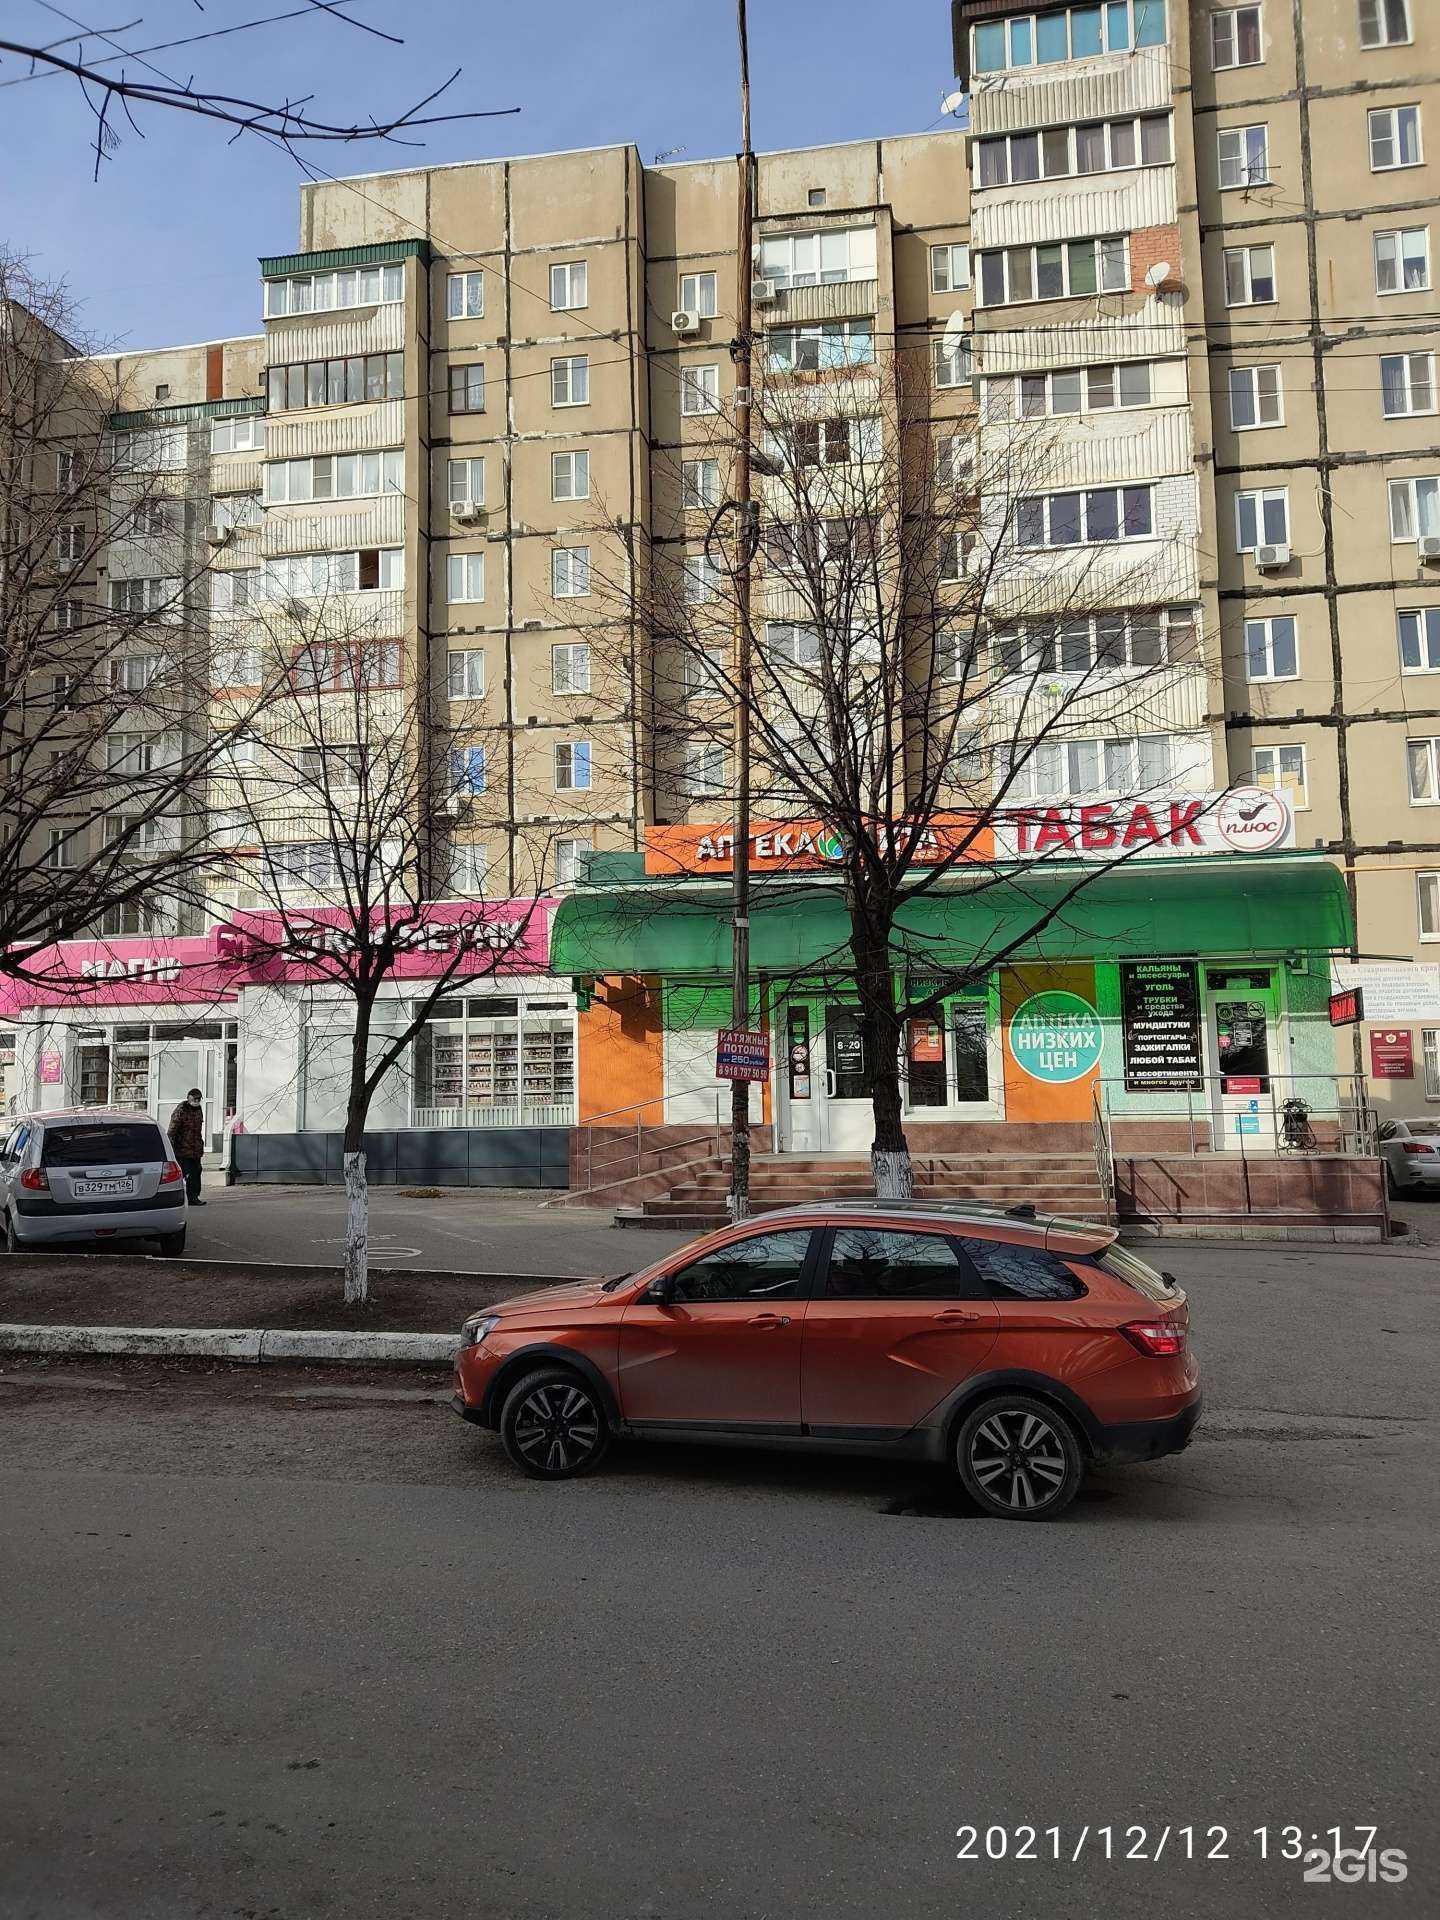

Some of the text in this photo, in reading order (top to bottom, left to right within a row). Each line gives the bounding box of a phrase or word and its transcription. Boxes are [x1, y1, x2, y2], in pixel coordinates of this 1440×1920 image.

[1009, 800, 1205, 853] ТАБАК
[696, 831, 817, 860] АПЕКА
[1136, 964, 1181, 973] КАЛЬЯНЫ
[1136, 972, 1190, 980] аксессуары
[1143, 996, 1178, 1004] ТРУБКИ
[1145, 1003, 1185, 1011] средства
[1019, 1012, 1095, 1030] АПТЕКА
[1133, 1021, 1191, 1030] МУНДШТУКИ
[1018, 1031, 1096, 1050] НИЗКИХ
[723, 1043, 765, 1056] ПОТОЛКИ
[1134, 1043, 1191, 1052] ЗАЖИГАЛКИ
[1039, 1051, 1078, 1072] ЦЕН
[1129, 1055, 1197, 1065] ЛЮБОЙ ТАБАК
[724, 1066, 738, 1076] 918
